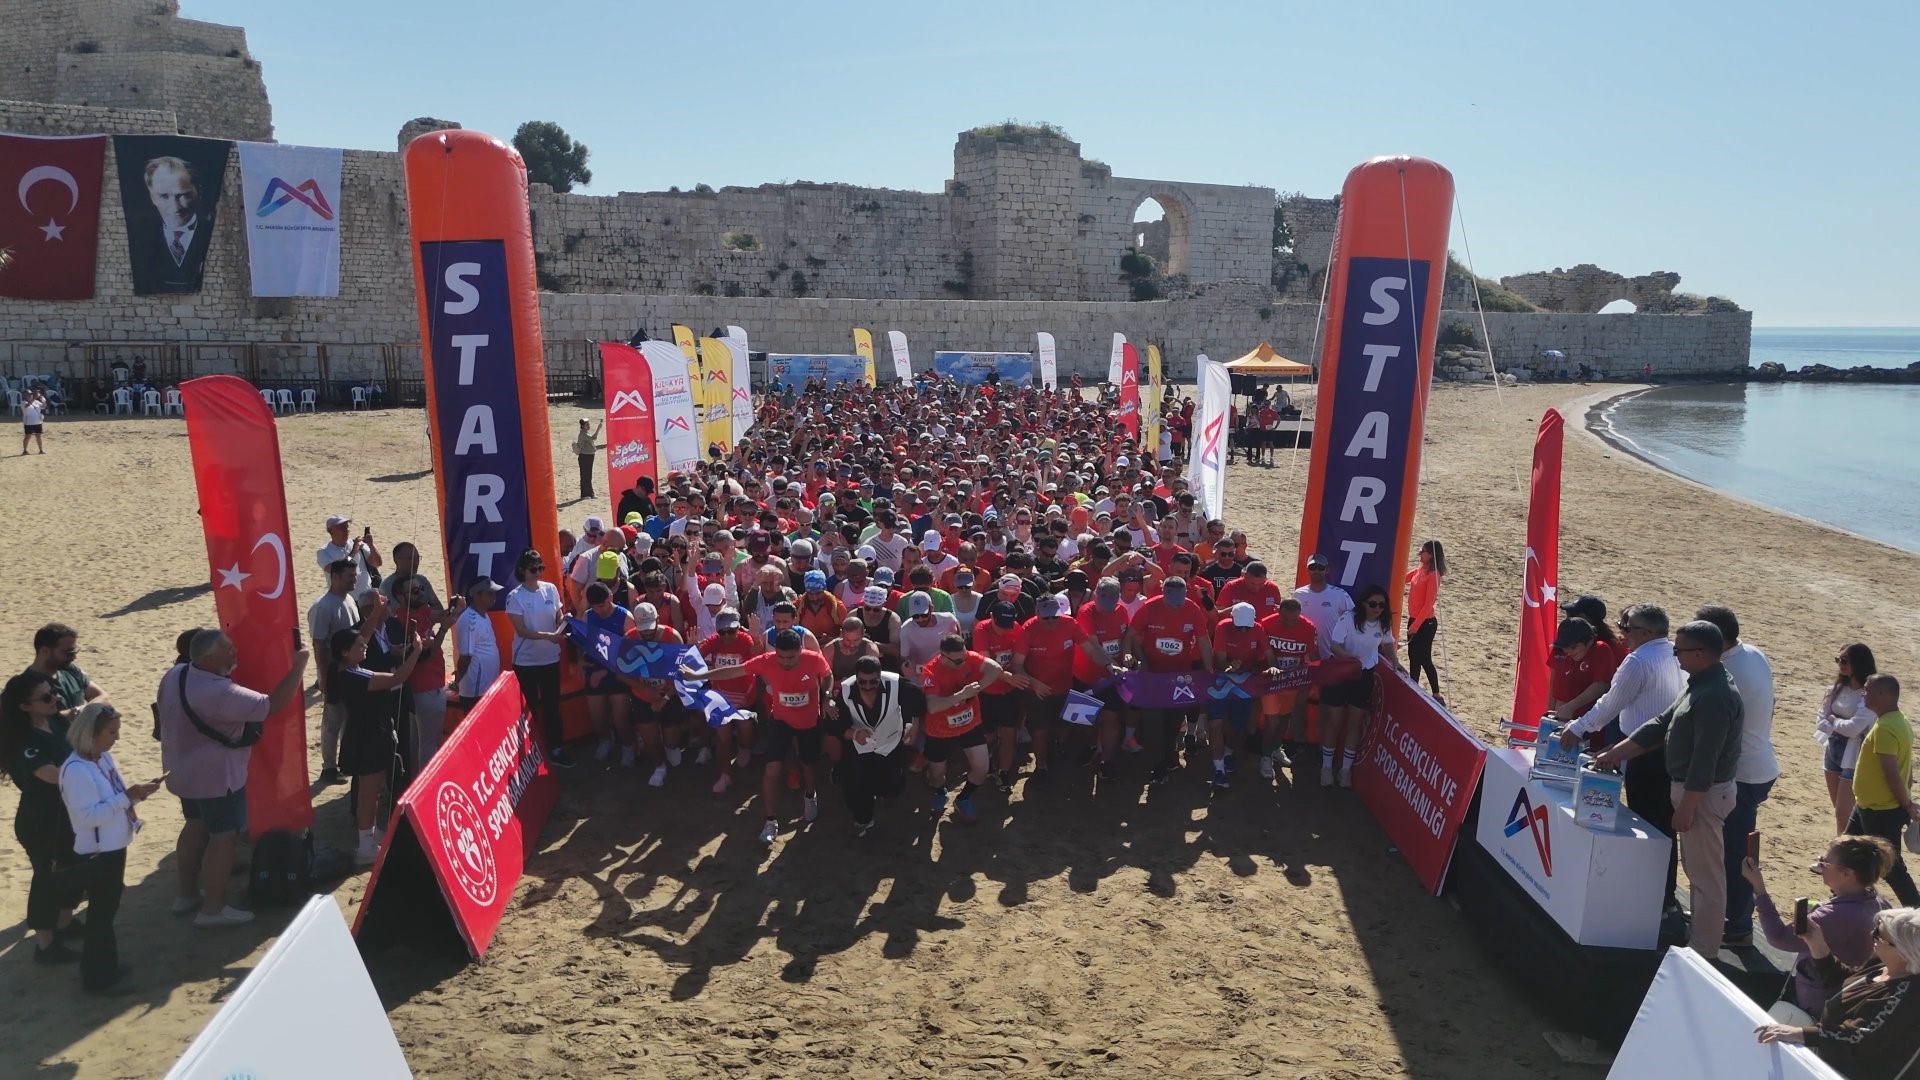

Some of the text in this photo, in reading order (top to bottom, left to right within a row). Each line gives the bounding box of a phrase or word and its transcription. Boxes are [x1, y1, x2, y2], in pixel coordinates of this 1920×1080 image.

[443, 262, 507, 580] START
[1339, 276, 1408, 588] START
[718, 658, 737, 666] 1543
[1160, 641, 1180, 650] 1062
[1269, 639, 1305, 652] AKUT
[952, 710, 972, 724] 1390
[472, 771, 495, 806] T.C.
[488, 724, 522, 783] GENÇLİK
[1374, 743, 1446, 840] SPOR BAKANLIĞI
[1383, 714, 1458, 807] T.C. GENÇLİK VE
[488, 793, 514, 840] SPOR
